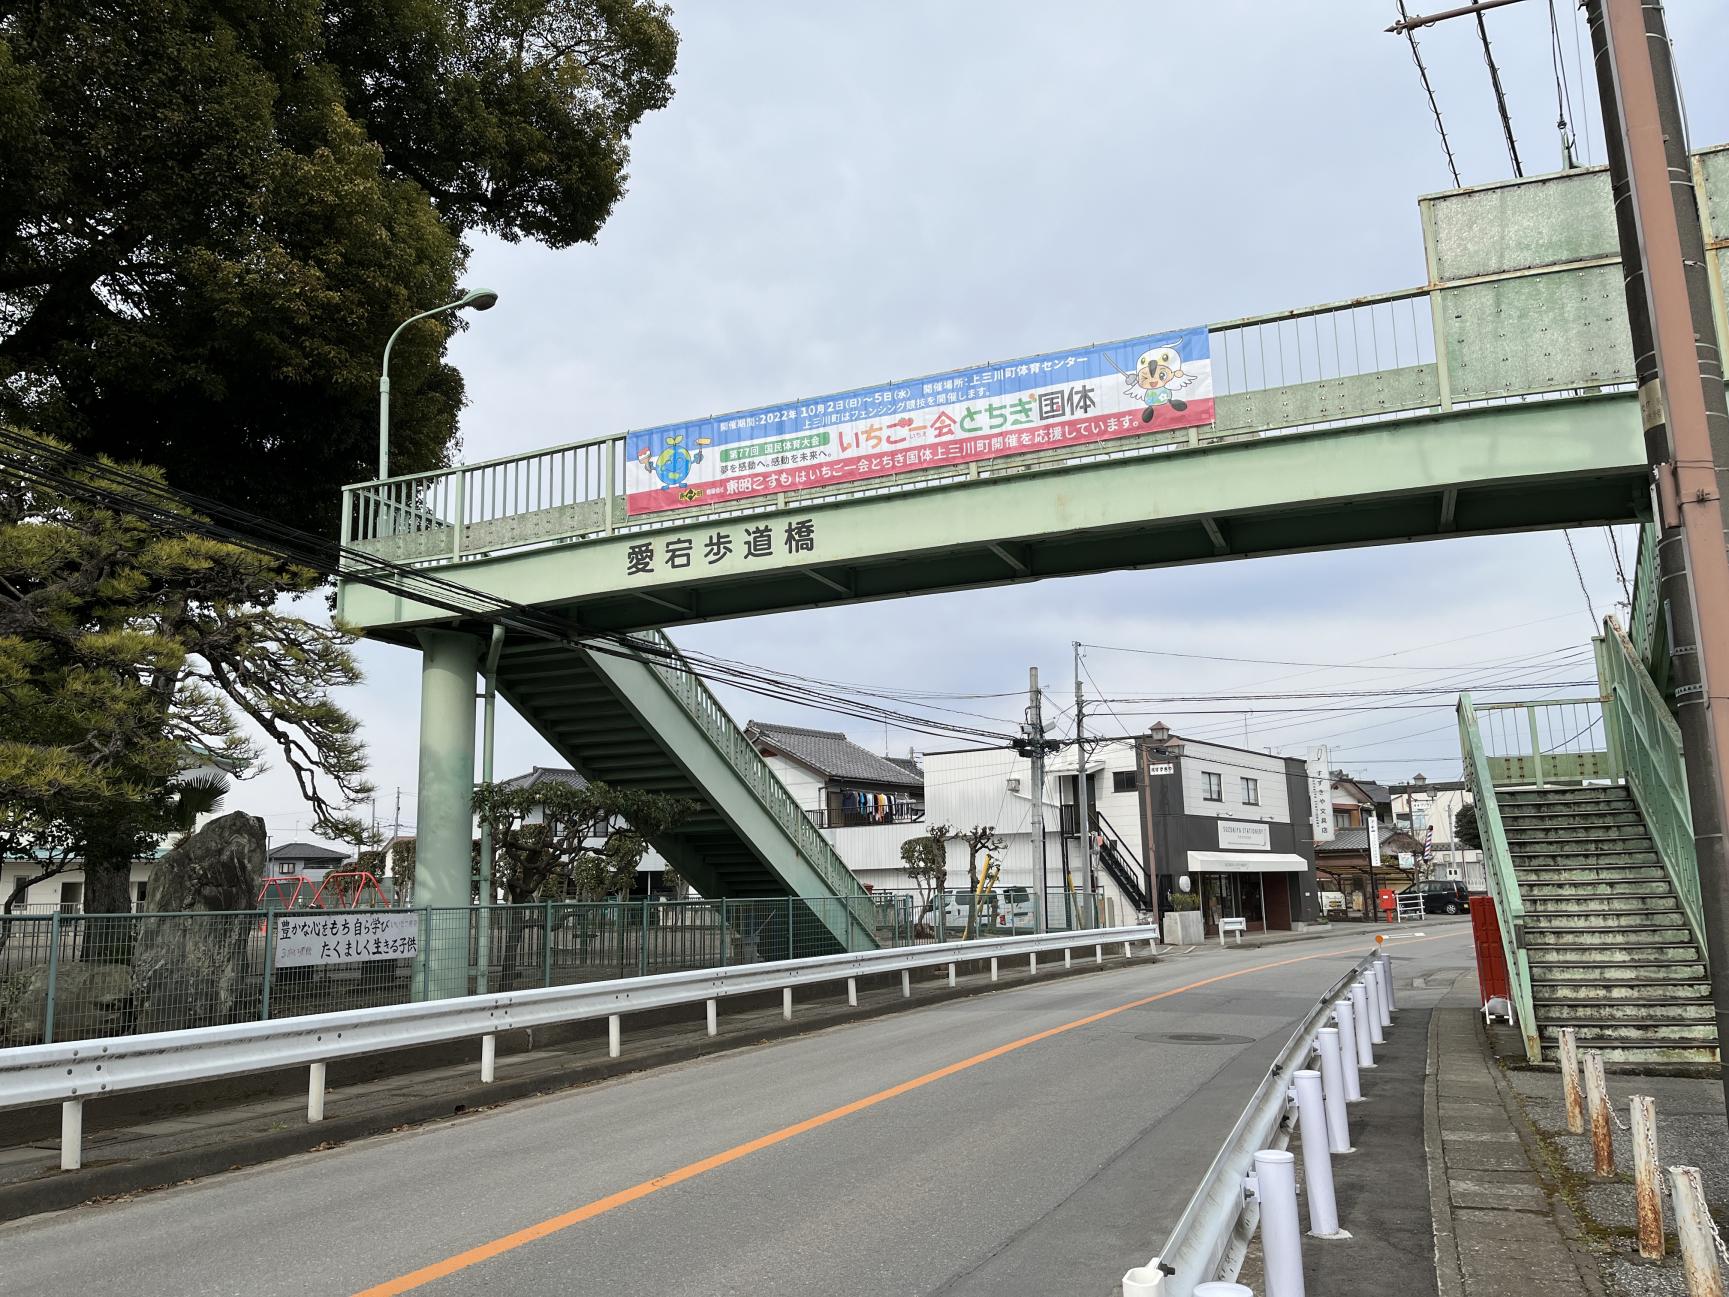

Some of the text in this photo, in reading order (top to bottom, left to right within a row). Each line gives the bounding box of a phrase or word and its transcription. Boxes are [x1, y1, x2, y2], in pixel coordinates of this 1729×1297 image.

[802, 387, 991, 429] 上三川町はフェンシング競技を開催します。
[720, 448, 833, 474] 夢を感動へ。感動を未来へ。
[764, 435, 821, 455] 国民体育大会
[627, 519, 815, 576] 愛宕歩道橋
[1316, 770, 1328, 834] すずきや文具店
[320, 936, 418, 959] たくましく生きる子供
